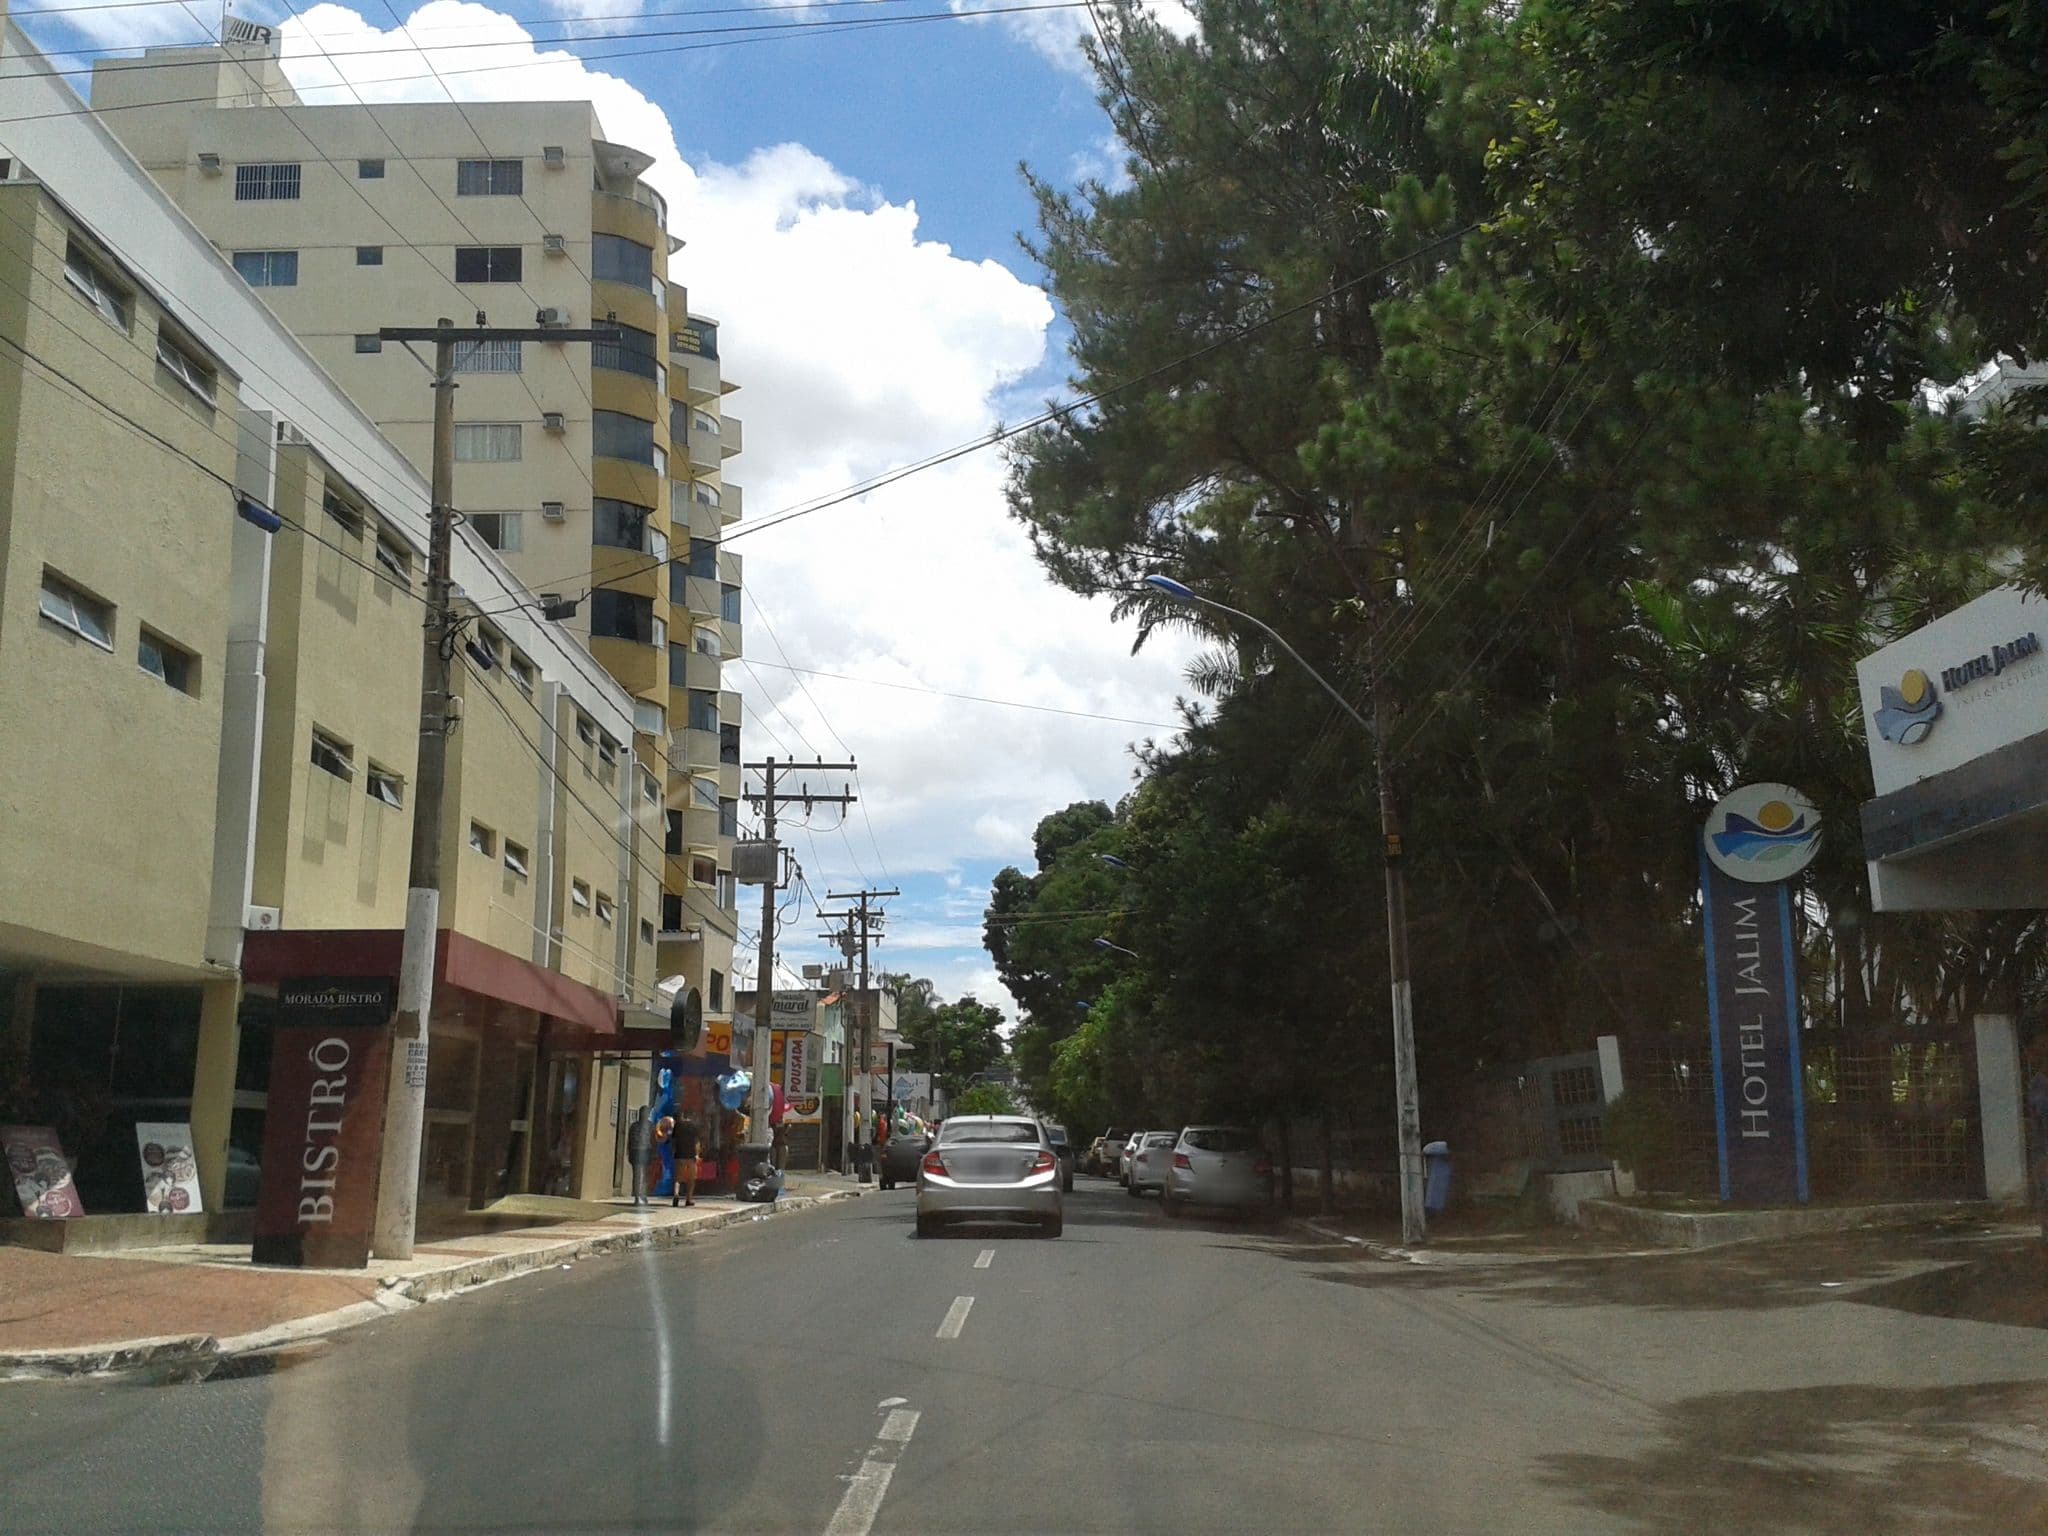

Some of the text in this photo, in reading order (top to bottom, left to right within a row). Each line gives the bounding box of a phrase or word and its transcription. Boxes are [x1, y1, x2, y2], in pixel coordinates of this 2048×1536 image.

[1941, 654, 1994, 693] HOTEL
[1991, 632, 2040, 676] JALIM
[285, 992, 382, 1004] MORADA BISTRÔ
[1733, 897, 1770, 1139] HOTEL JALIM
[790, 1039, 803, 1093] POUSADA
[297, 1037, 350, 1224] BISTRÔ
